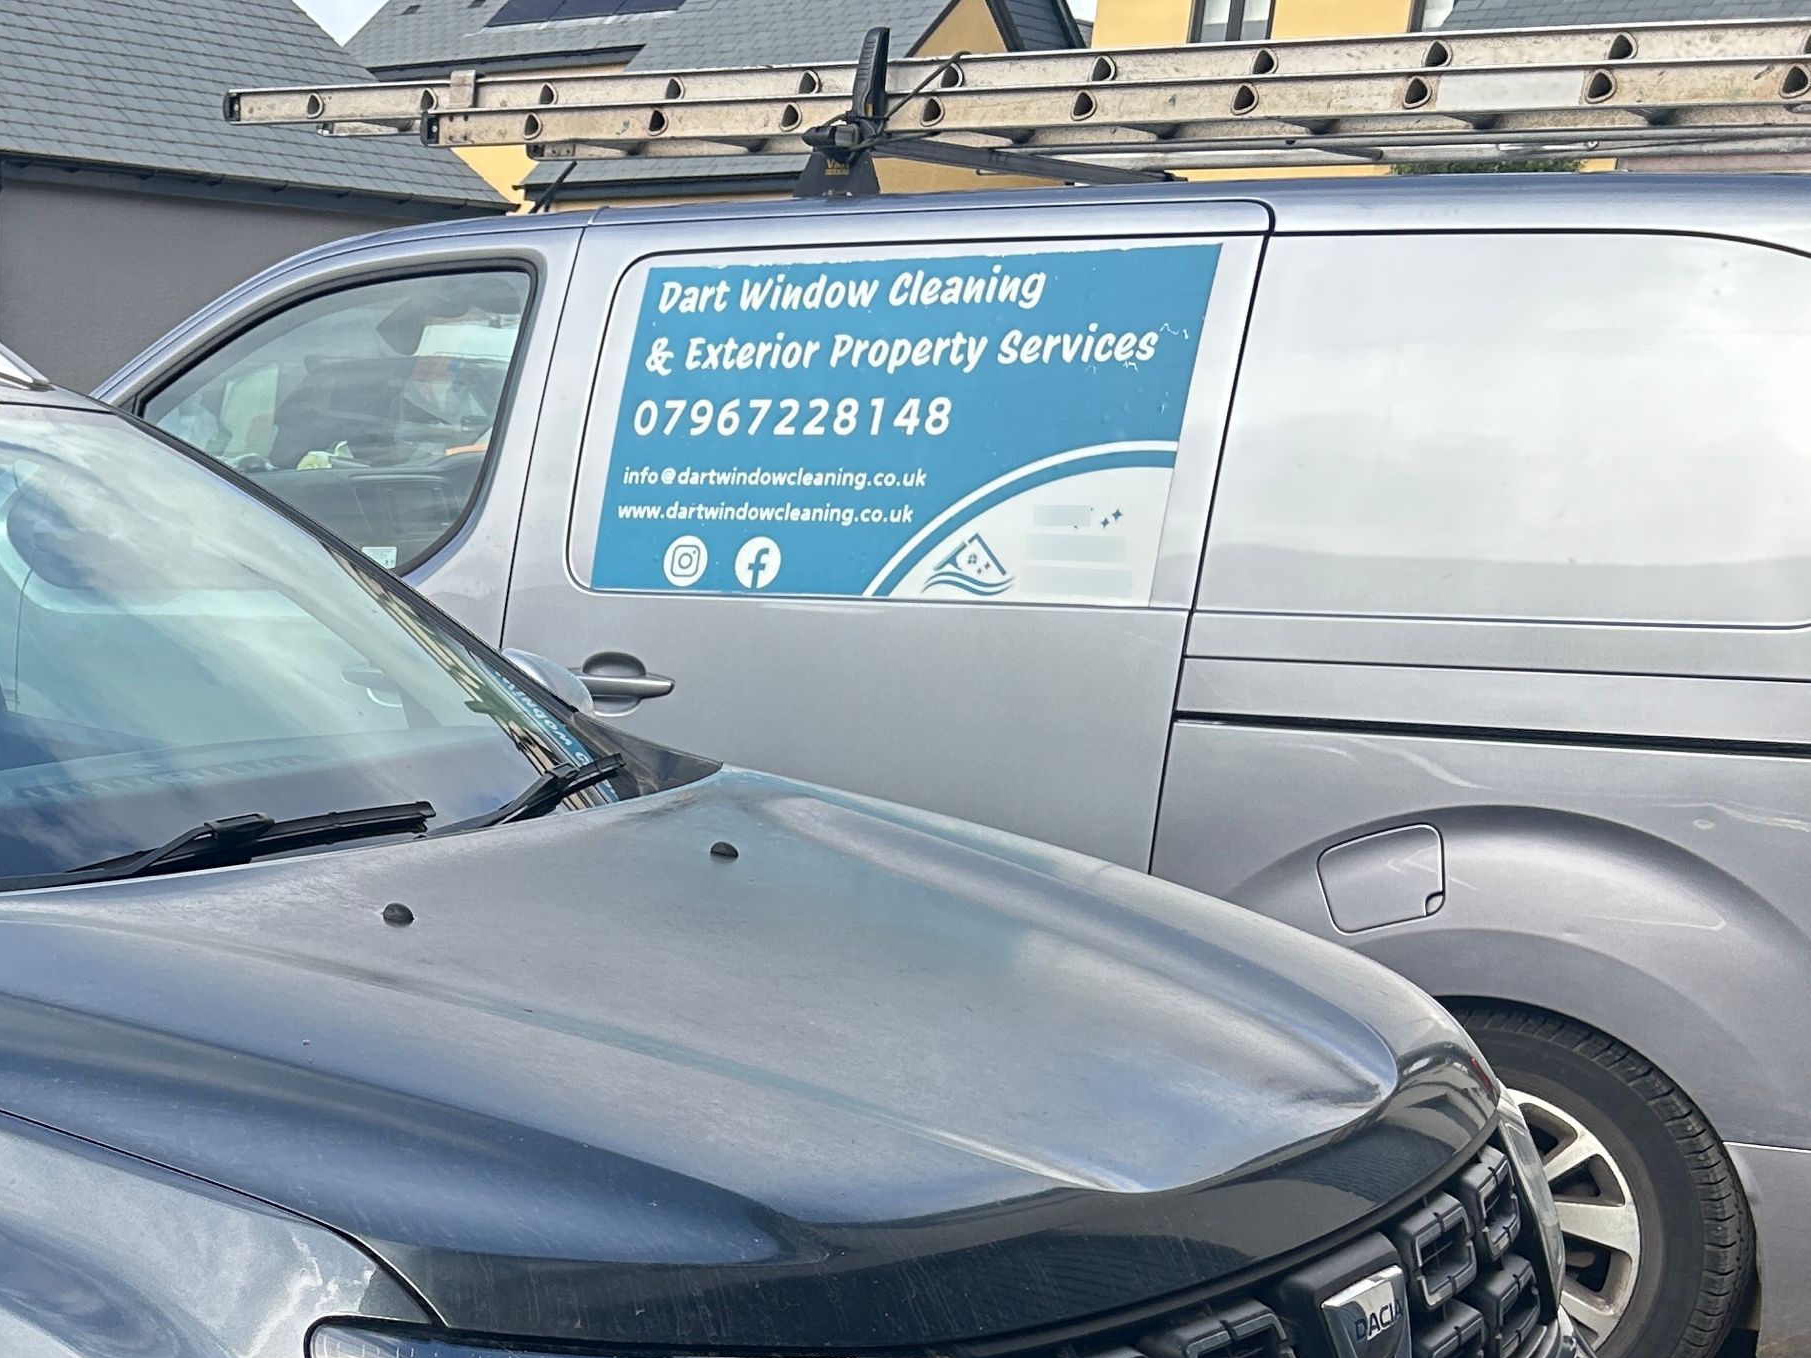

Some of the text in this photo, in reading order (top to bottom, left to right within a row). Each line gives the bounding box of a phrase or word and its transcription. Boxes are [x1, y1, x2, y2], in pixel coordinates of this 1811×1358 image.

[658, 264, 1047, 314] Dart Window Cleaning
[645, 322, 1159, 377] & Exterior Property Services
[633, 396, 952, 437] 07967228148
[623, 466, 927, 491] info@dartwindowcleaning.co.uk
[618, 501, 914, 527] www.dartwindowcleaning.co.uk
[1355, 1300, 1403, 1341] DACIA
